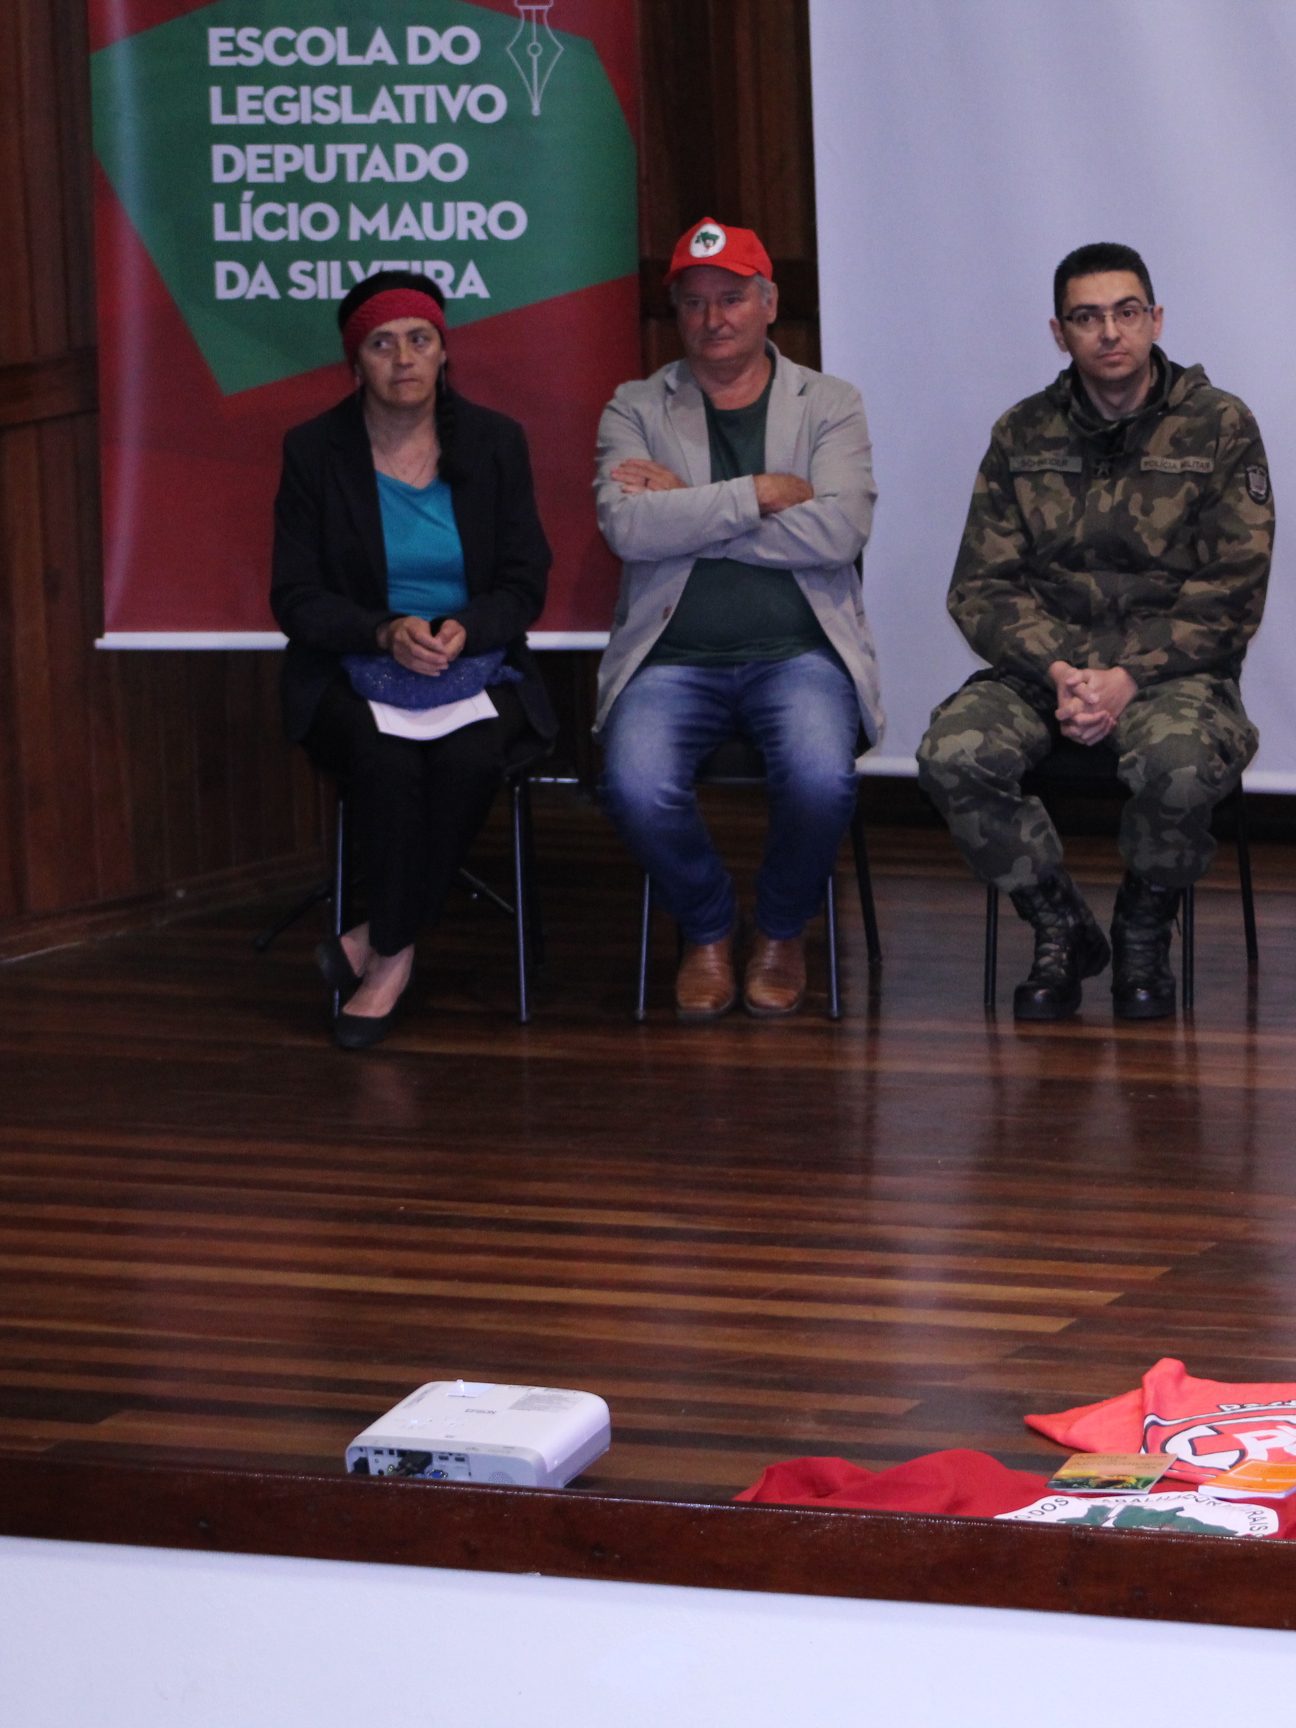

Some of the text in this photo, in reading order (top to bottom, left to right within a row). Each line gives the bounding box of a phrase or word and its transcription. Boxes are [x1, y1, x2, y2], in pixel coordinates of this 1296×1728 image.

[207, 26, 481, 67] ESCOLA DO
[210, 84, 508, 125] LEGISLATIVO
[211, 143, 469, 183] DEPUTADO
[213, 191, 528, 242] LÍCIO MAURO
[214, 259, 491, 300] DA SILVRA
[1029, 1497, 1069, 1516] DOS
